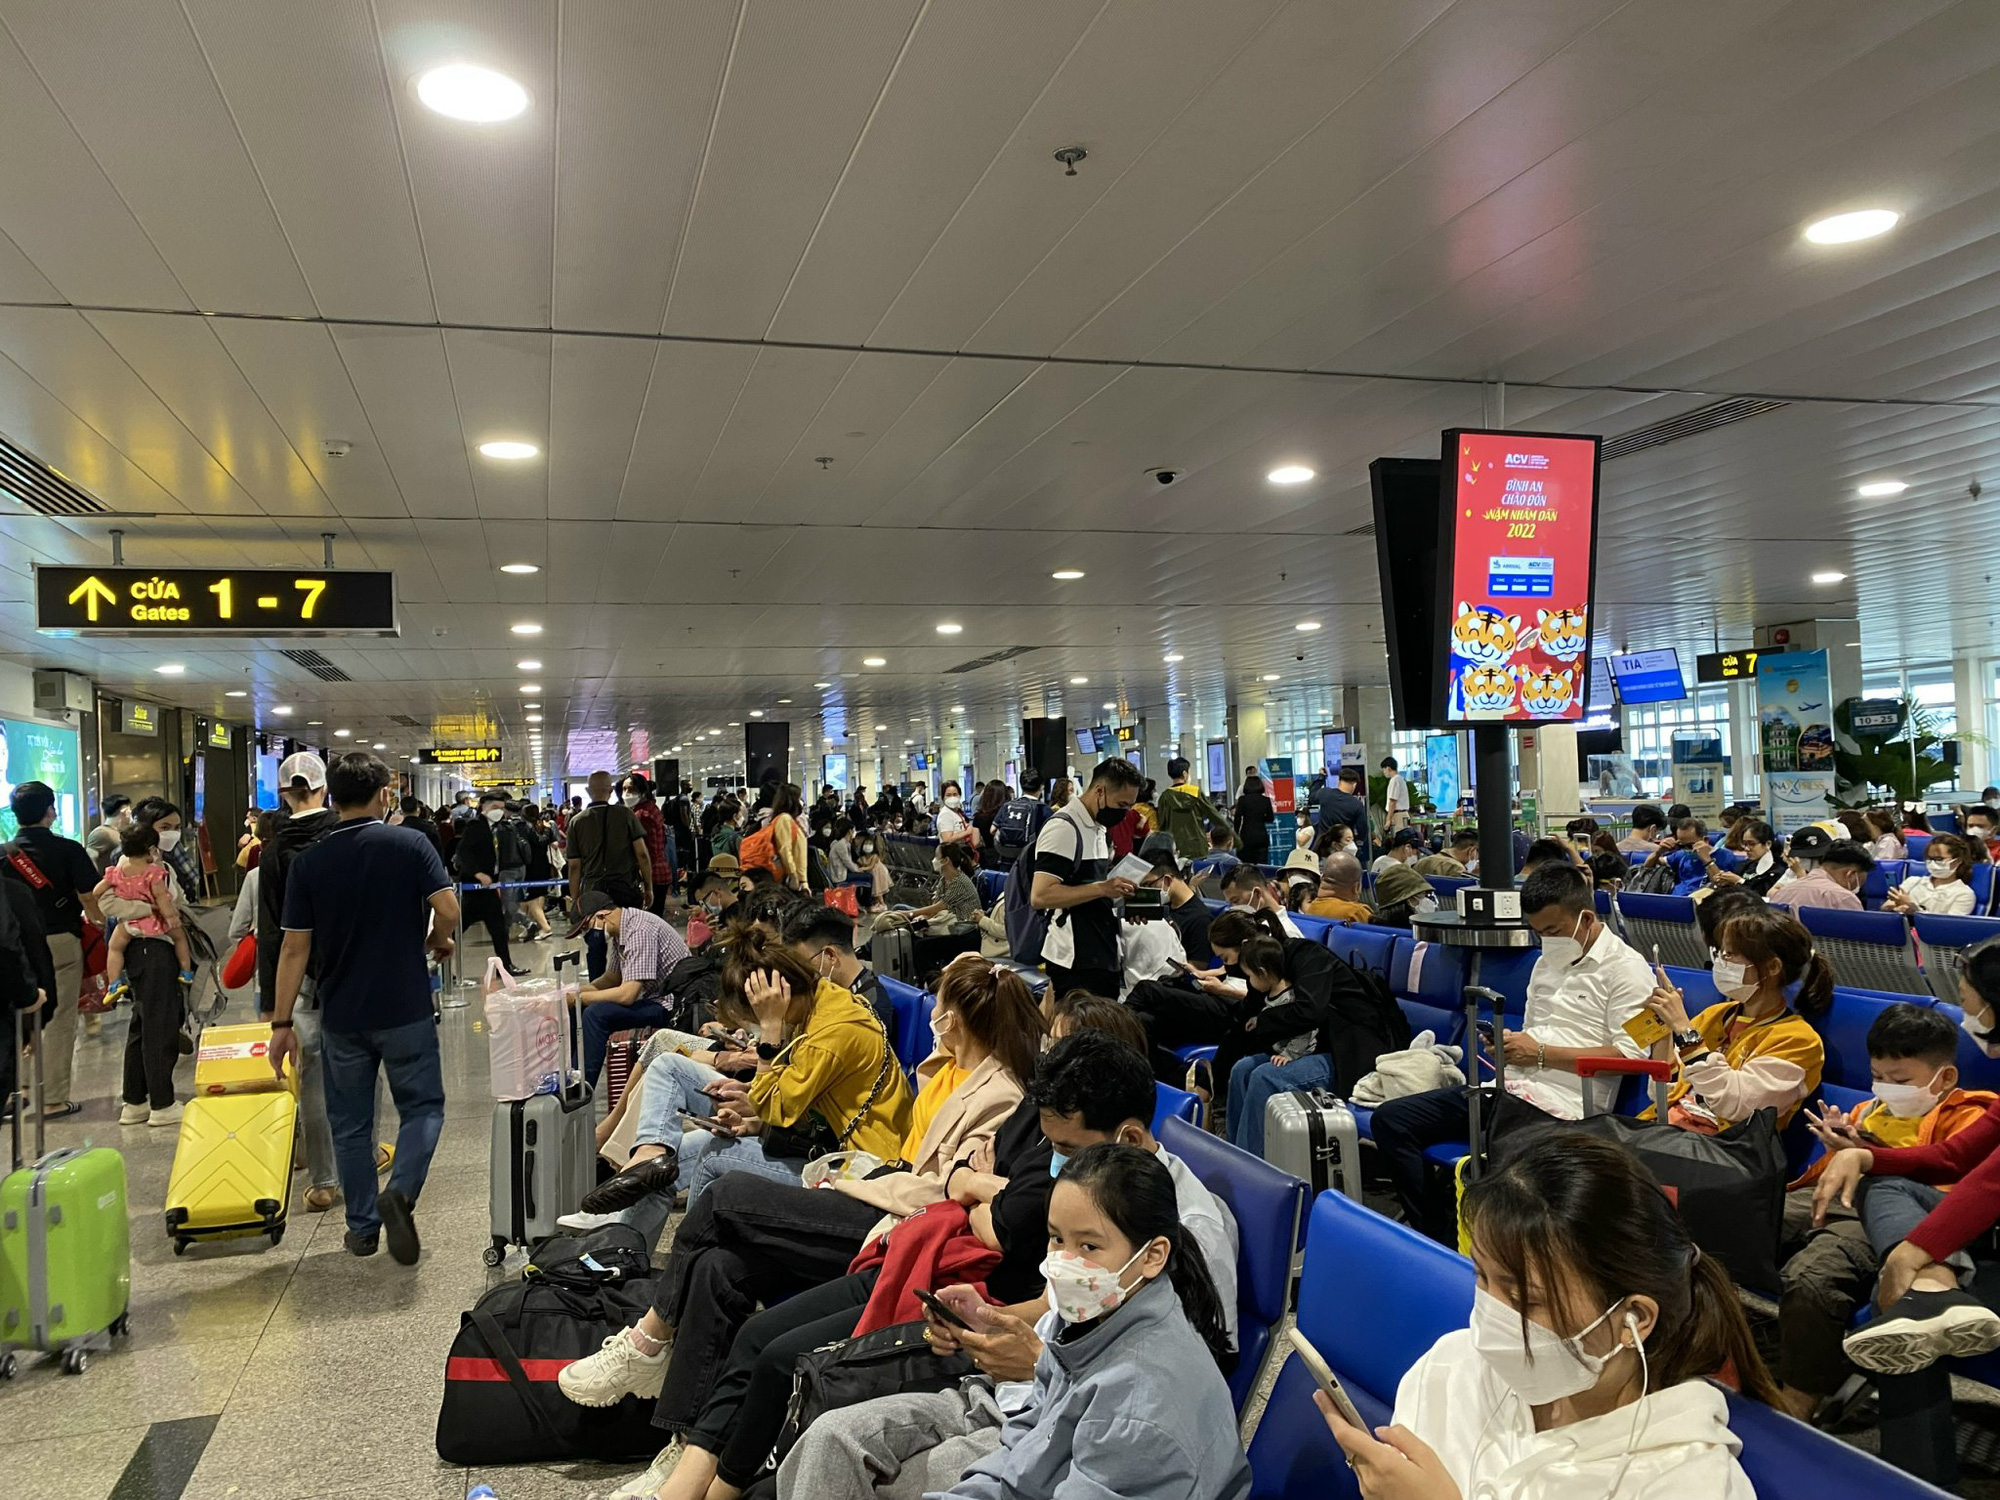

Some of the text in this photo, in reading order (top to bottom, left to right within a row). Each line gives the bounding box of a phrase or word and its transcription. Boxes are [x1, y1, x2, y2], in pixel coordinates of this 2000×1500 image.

[1504, 453, 1529, 465] ACV
[1505, 478, 1544, 492] BÌNH AN
[1501, 492, 1526, 506] CHÀO
[1506, 523, 1536, 538] 2022
[130, 577, 326, 619] CỬA 1 - 7
[131, 604, 190, 621] Gates
[1622, 659, 1642, 671] TIA
[1722, 655, 1738, 666] CỬA
[1746, 653, 1758, 673] 7
[1881, 715, 1893, 724] 25
